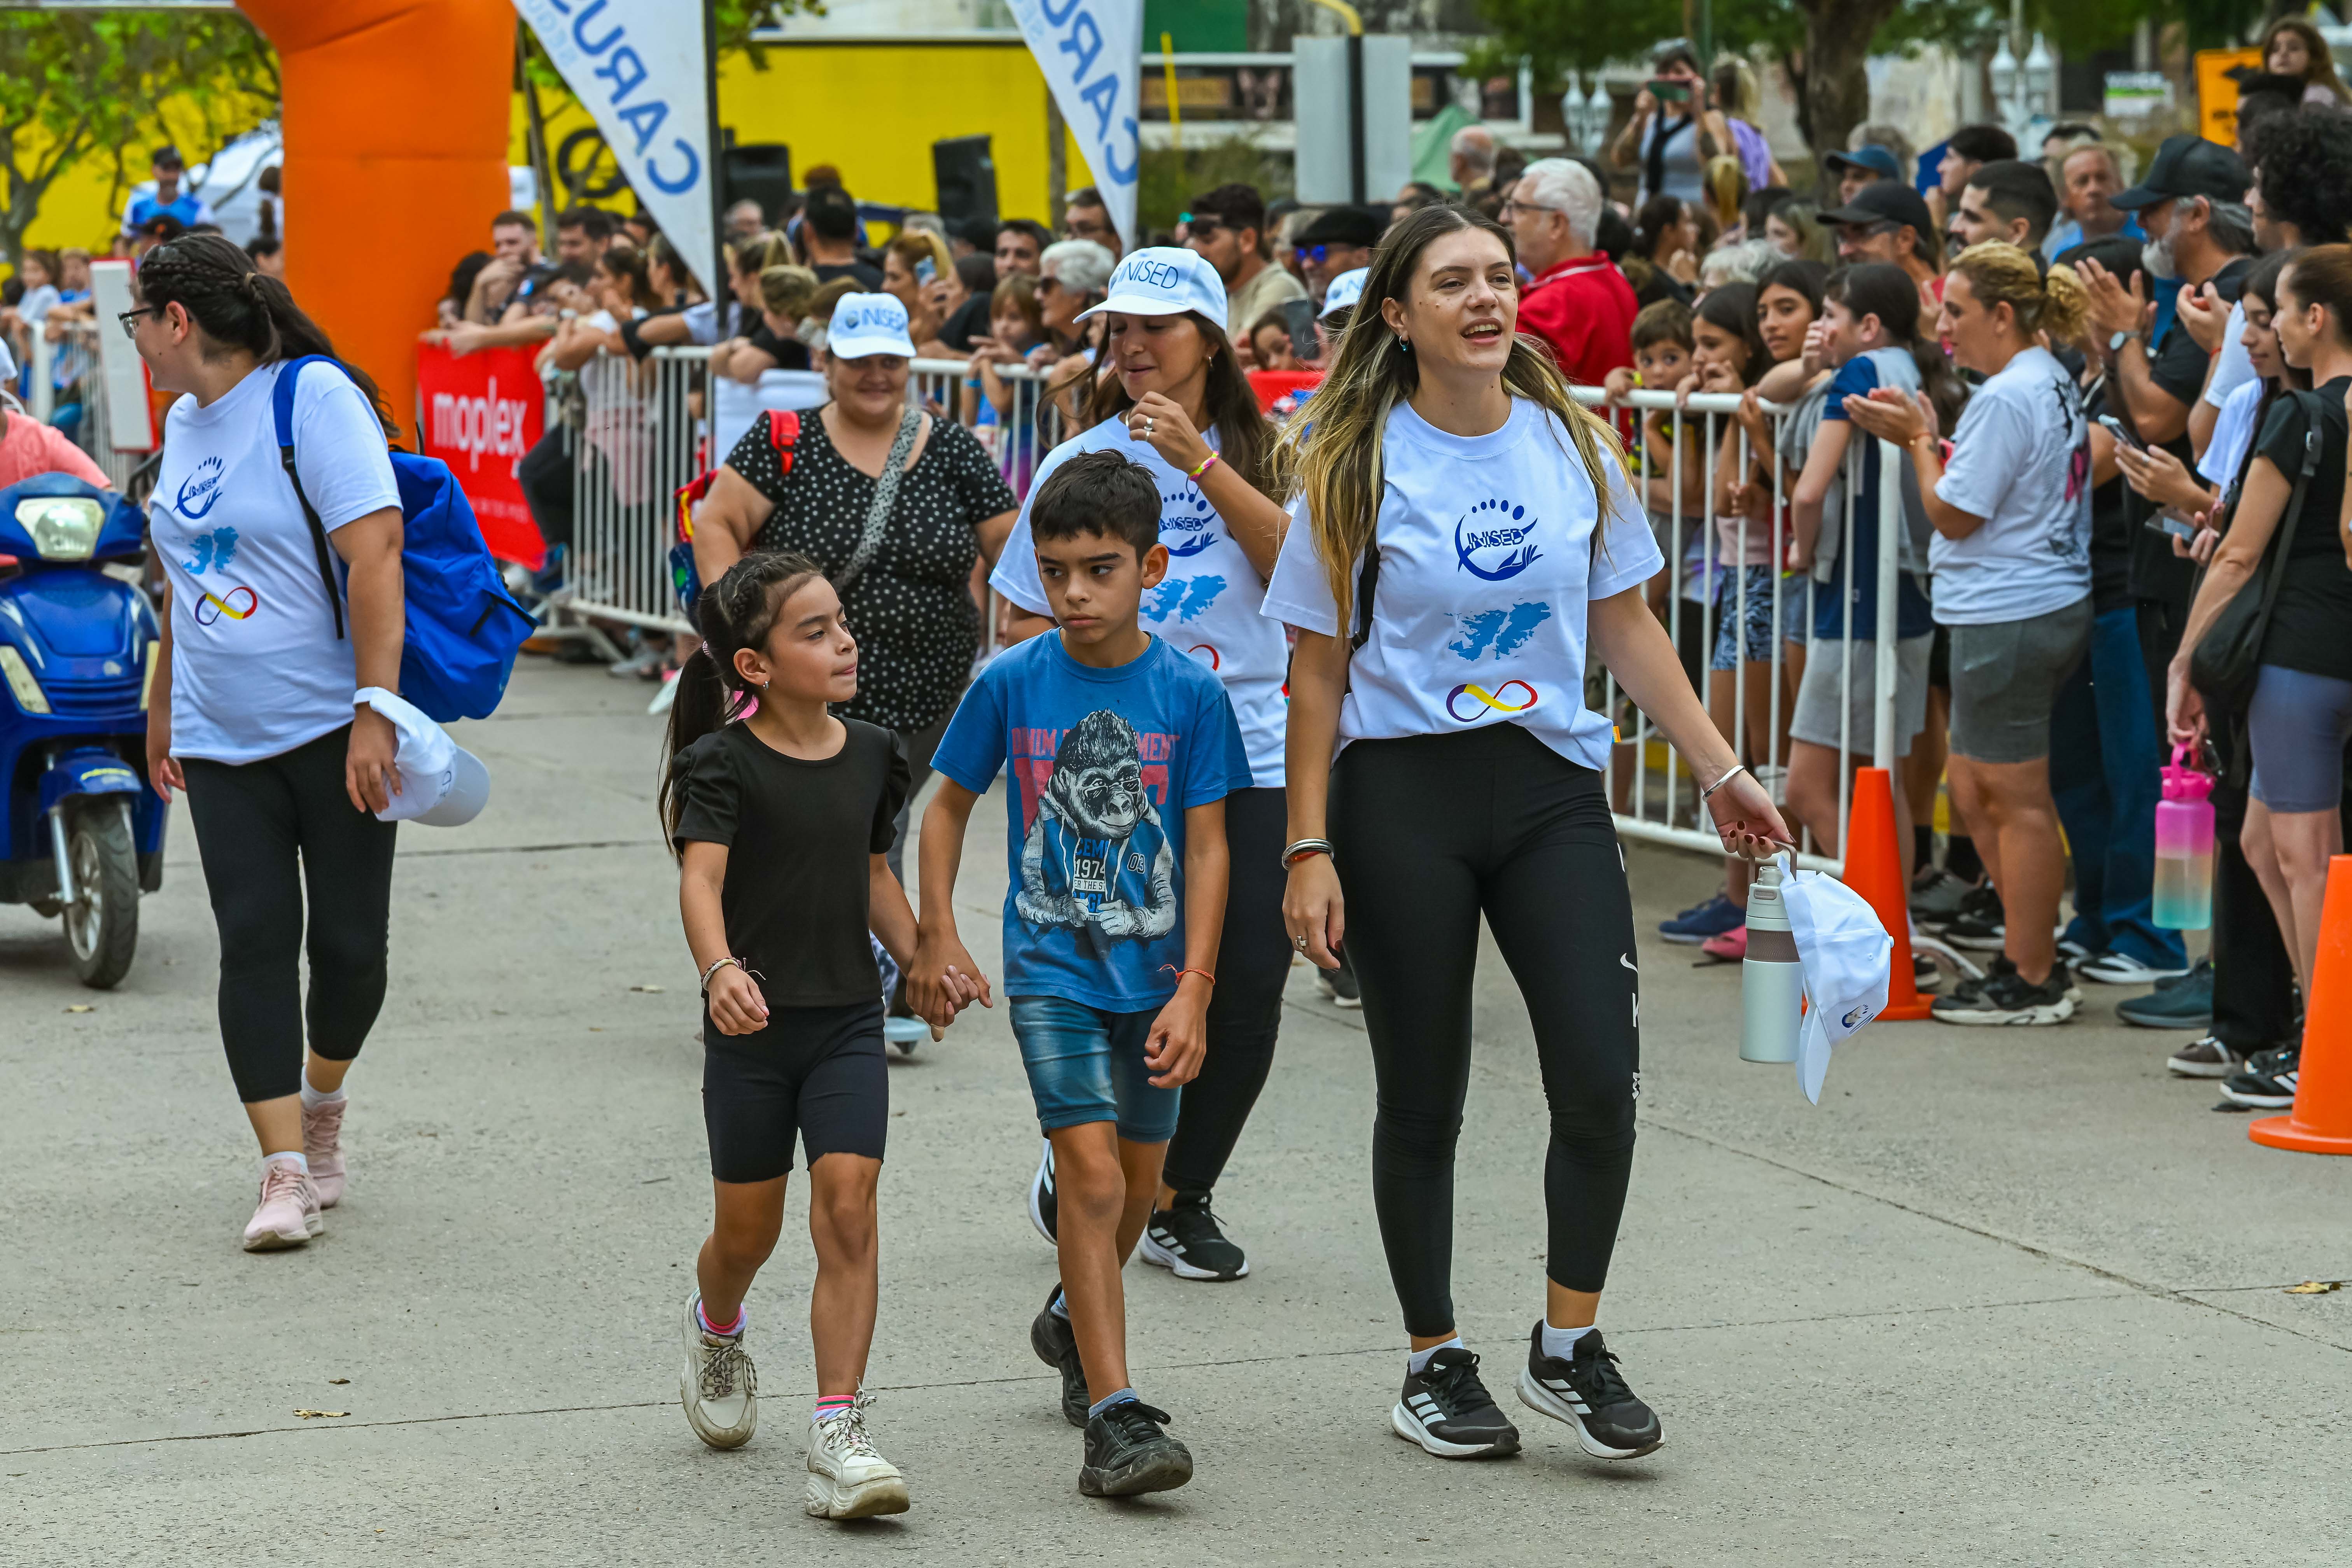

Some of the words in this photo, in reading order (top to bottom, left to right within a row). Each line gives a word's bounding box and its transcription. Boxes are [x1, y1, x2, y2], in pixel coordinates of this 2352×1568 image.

[432, 375, 527, 474] moplex
[1159, 516, 1204, 532] NISED
[1466, 528, 1524, 549] INISED
[1127, 852, 1145, 874] 03
[1084, 880, 1096, 890] THE
